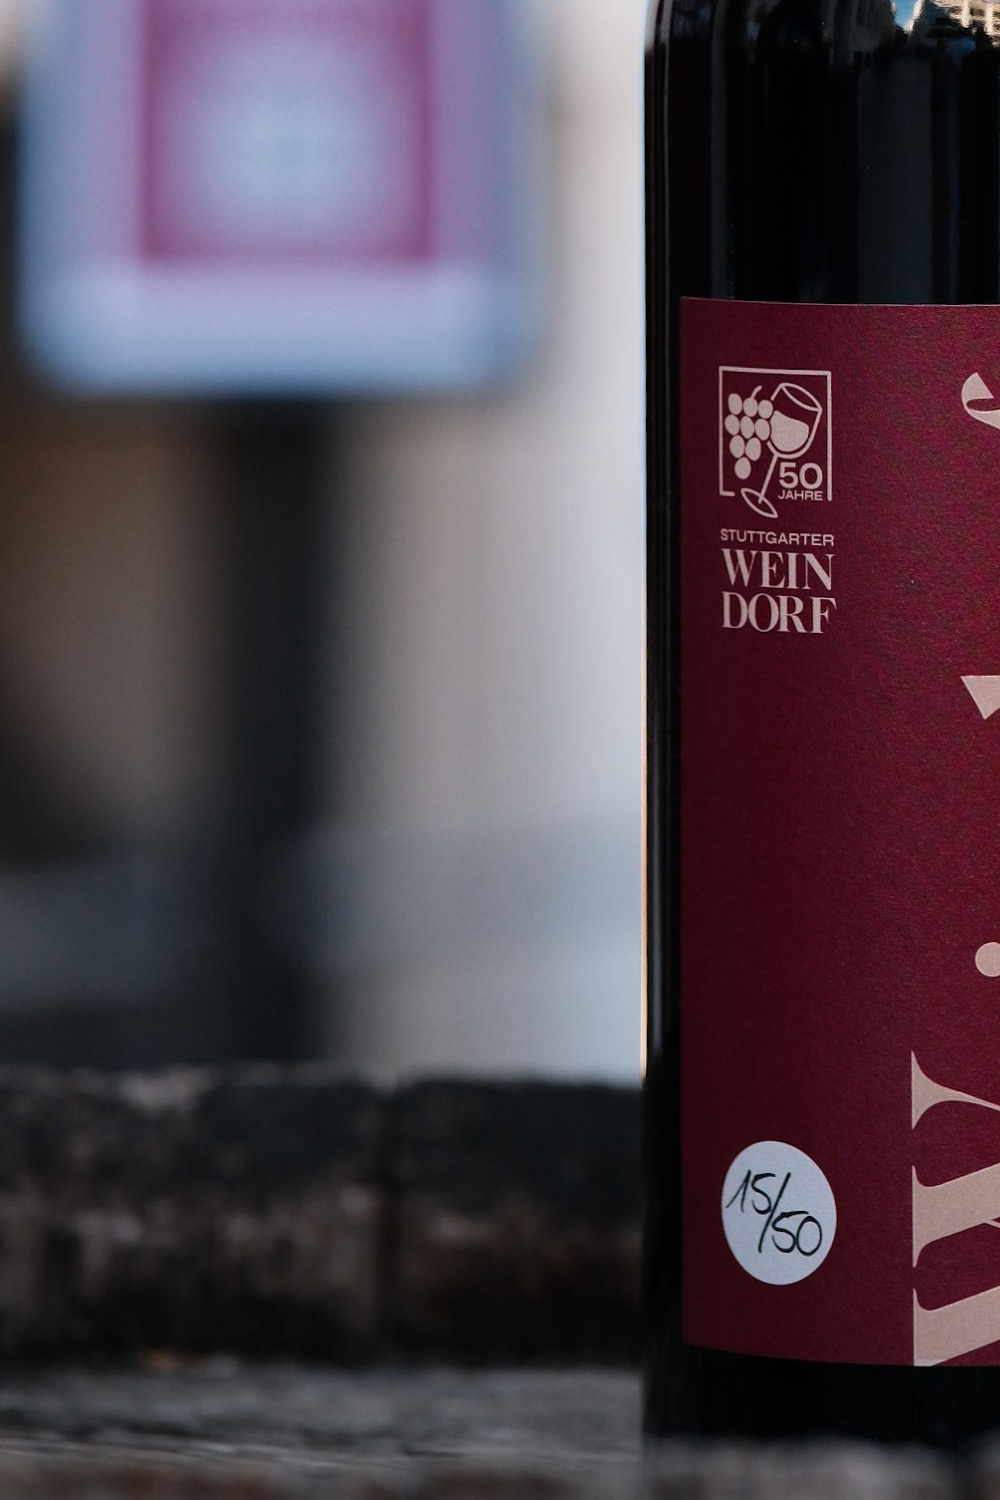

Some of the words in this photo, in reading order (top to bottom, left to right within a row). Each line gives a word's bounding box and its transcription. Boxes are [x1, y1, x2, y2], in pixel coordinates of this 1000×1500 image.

[778, 462, 823, 490] 50
[777, 490, 823, 501] JAHRE
[720, 529, 835, 546] STUTTGARTER
[722, 548, 835, 591] WEIN
[722, 591, 837, 634] DORF
[725, 1169, 822, 1257] 15/50
